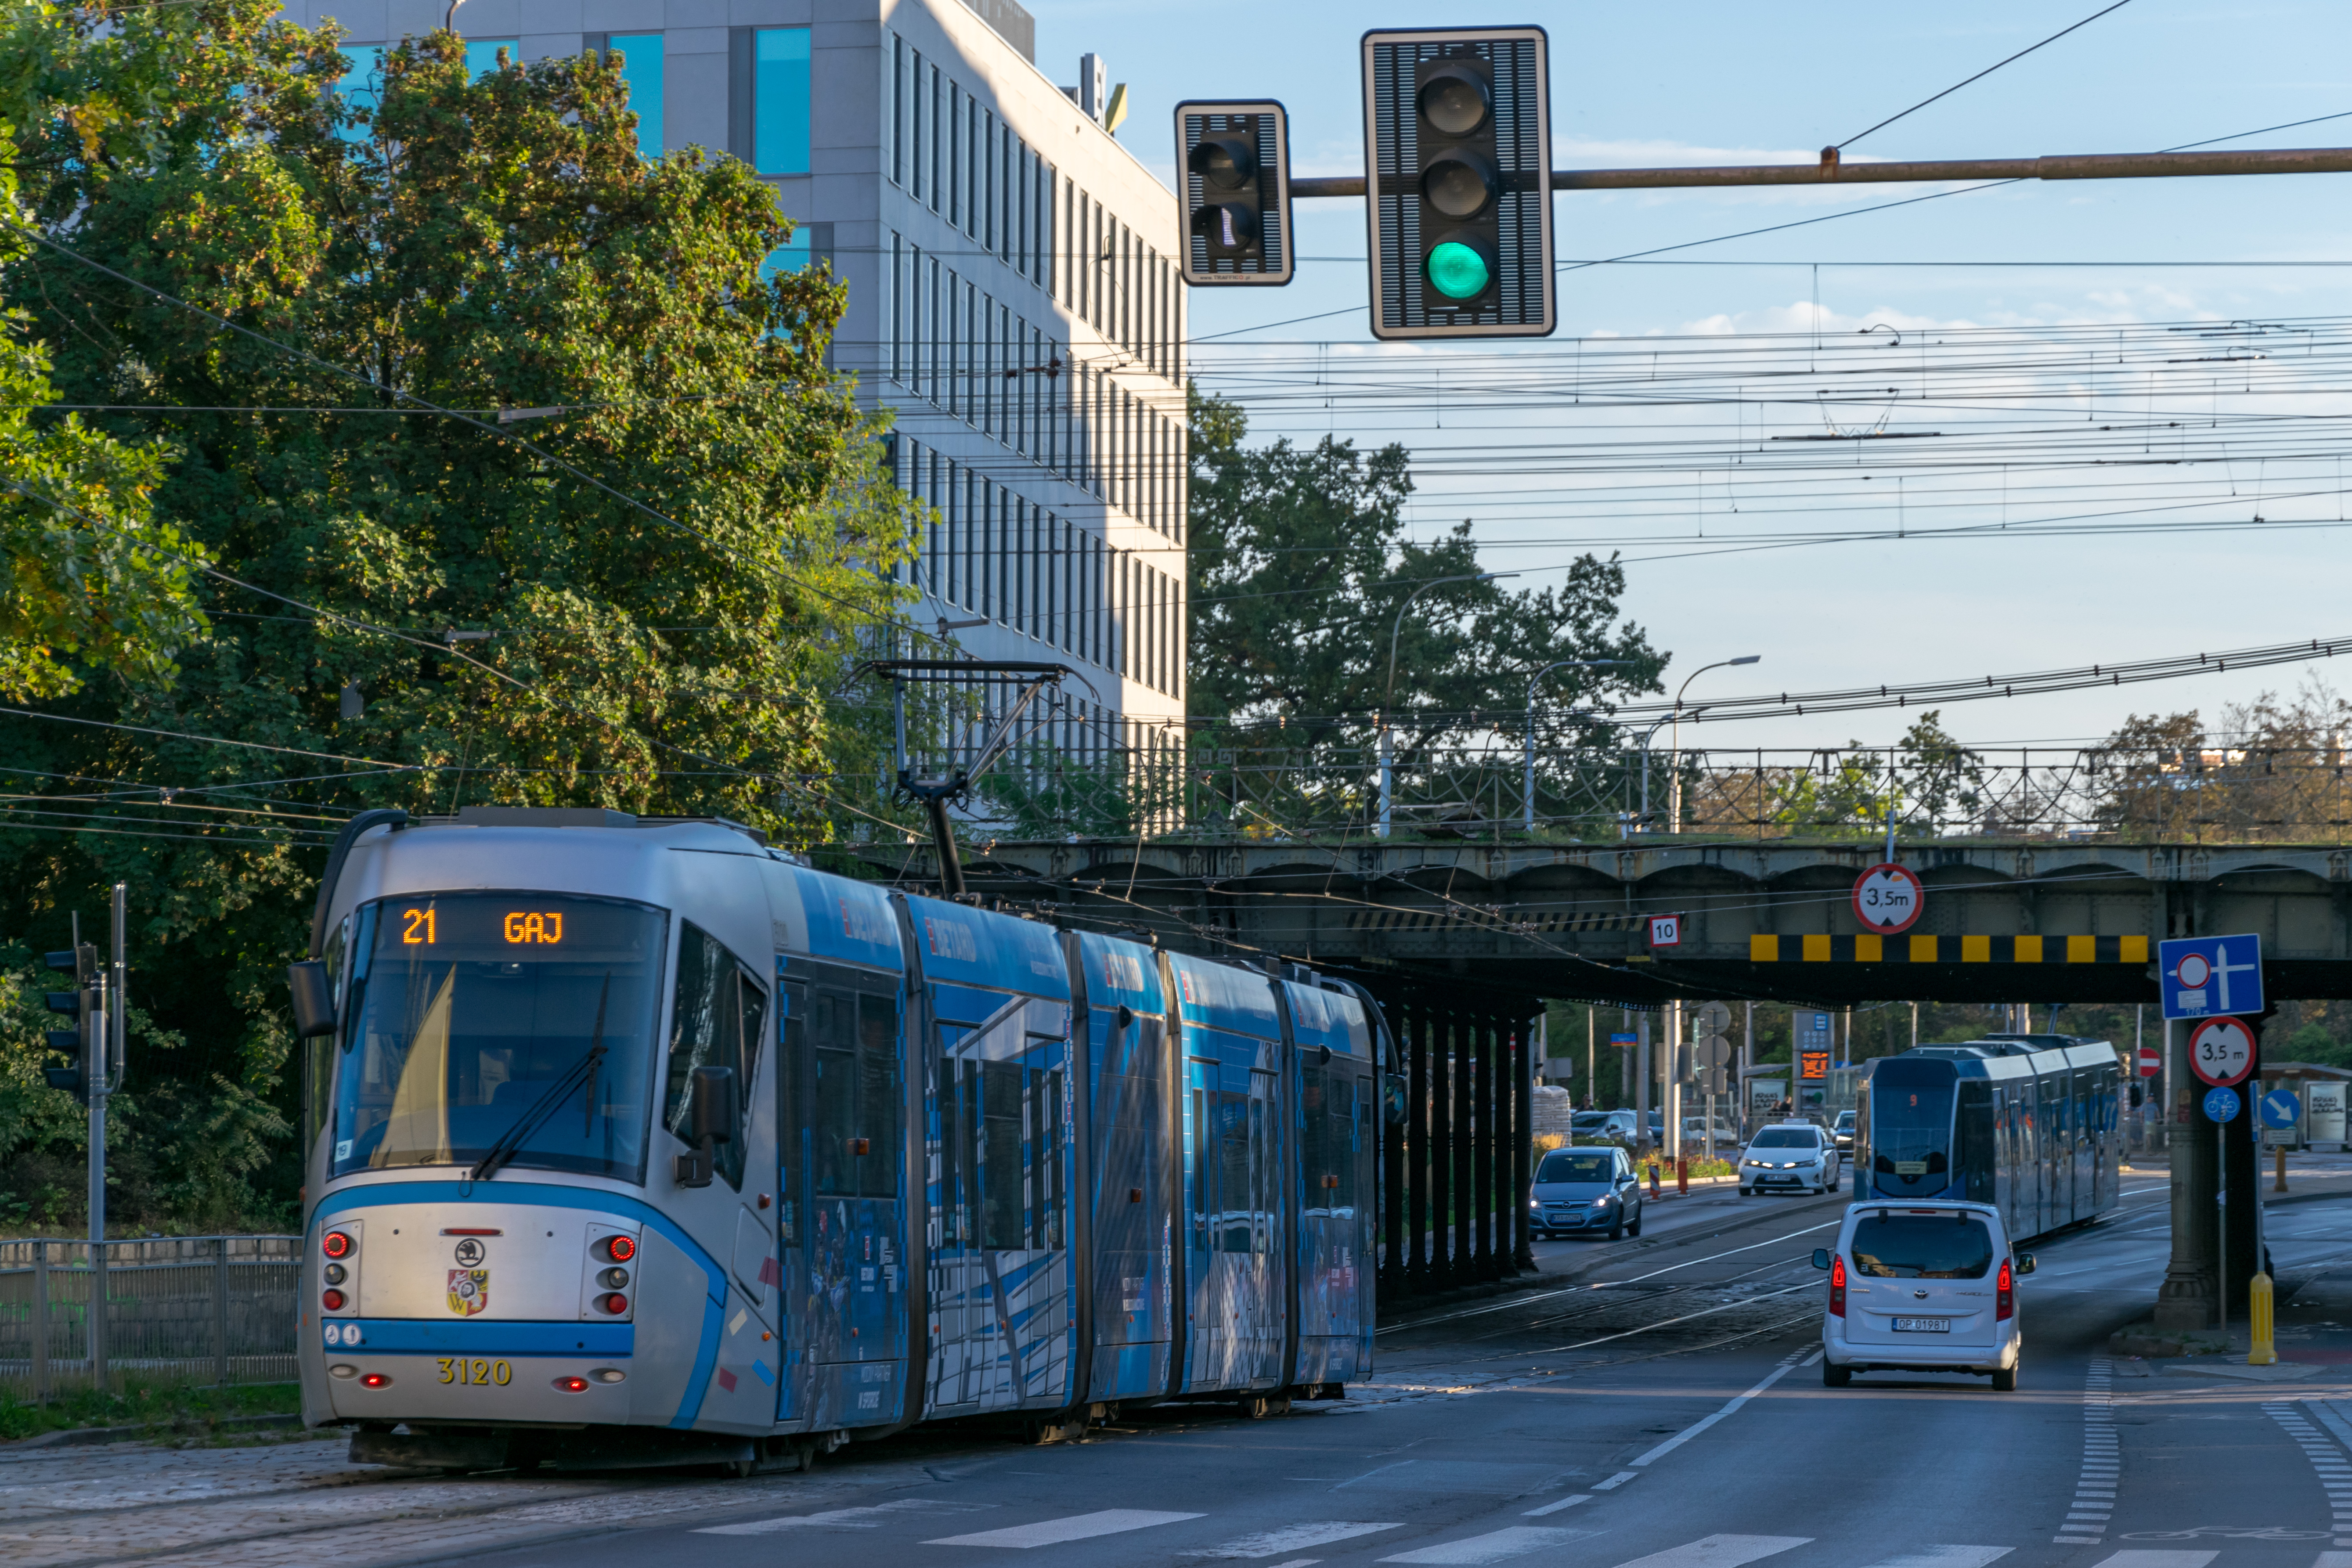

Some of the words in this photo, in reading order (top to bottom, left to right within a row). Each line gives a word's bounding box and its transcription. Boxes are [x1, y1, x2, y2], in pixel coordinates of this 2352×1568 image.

[403, 908, 436, 944] 21
[504, 912, 563, 944] GAJ
[1656, 924, 1674, 939] 10
[2186, 1007, 2201, 1016] 170
[2202, 1043, 2227, 1062] 3,5
[1909, 1094, 1918, 1107] 9
[337, 1144, 347, 1156] 19
[1899, 1319, 1912, 1329] OP
[1915, 1320, 1947, 1330] 0198T
[436, 1357, 512, 1386] 3120
